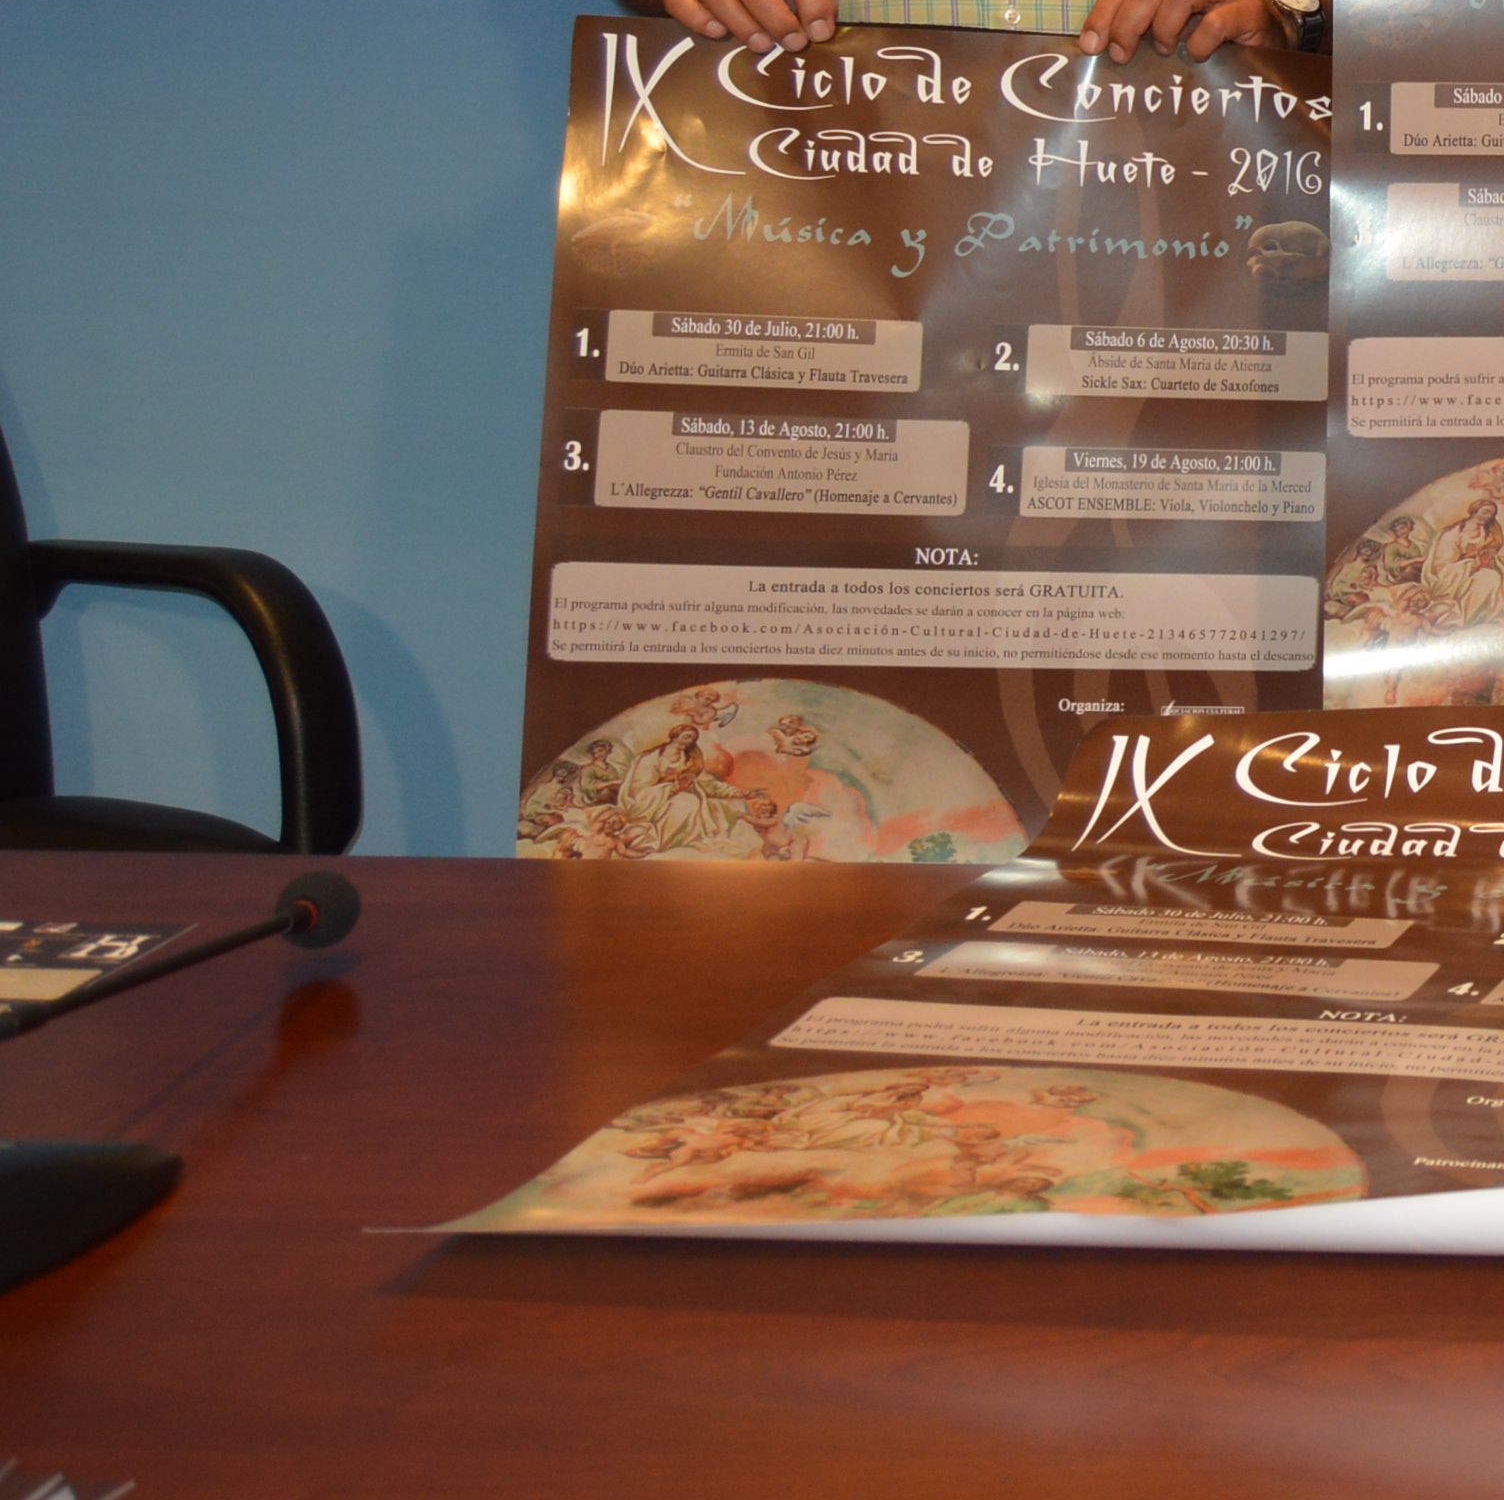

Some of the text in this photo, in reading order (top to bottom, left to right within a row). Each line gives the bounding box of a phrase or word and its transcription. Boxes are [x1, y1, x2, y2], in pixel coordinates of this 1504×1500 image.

[602, 32, 1333, 175] IX Ciclo de Conciertos
[747, 127, 1324, 198] Ciudad de Huete 2016
[671, 317, 859, 340] Sábado 30 de Julio, 21:00 h.
[619, 361, 907, 385] Dúo Arietta: Guitarra Clásica y Flauta Travesera
[915, 546, 979, 567] NOTA:
[1058, 697, 1125, 717] Organiza:
[1071, 733, 1242, 860] IX
[1234, 730, 1437, 807] Ciclo
[1250, 821, 1458, 861] Ciudad
[1319, 1009, 1407, 1024] NOTA:
